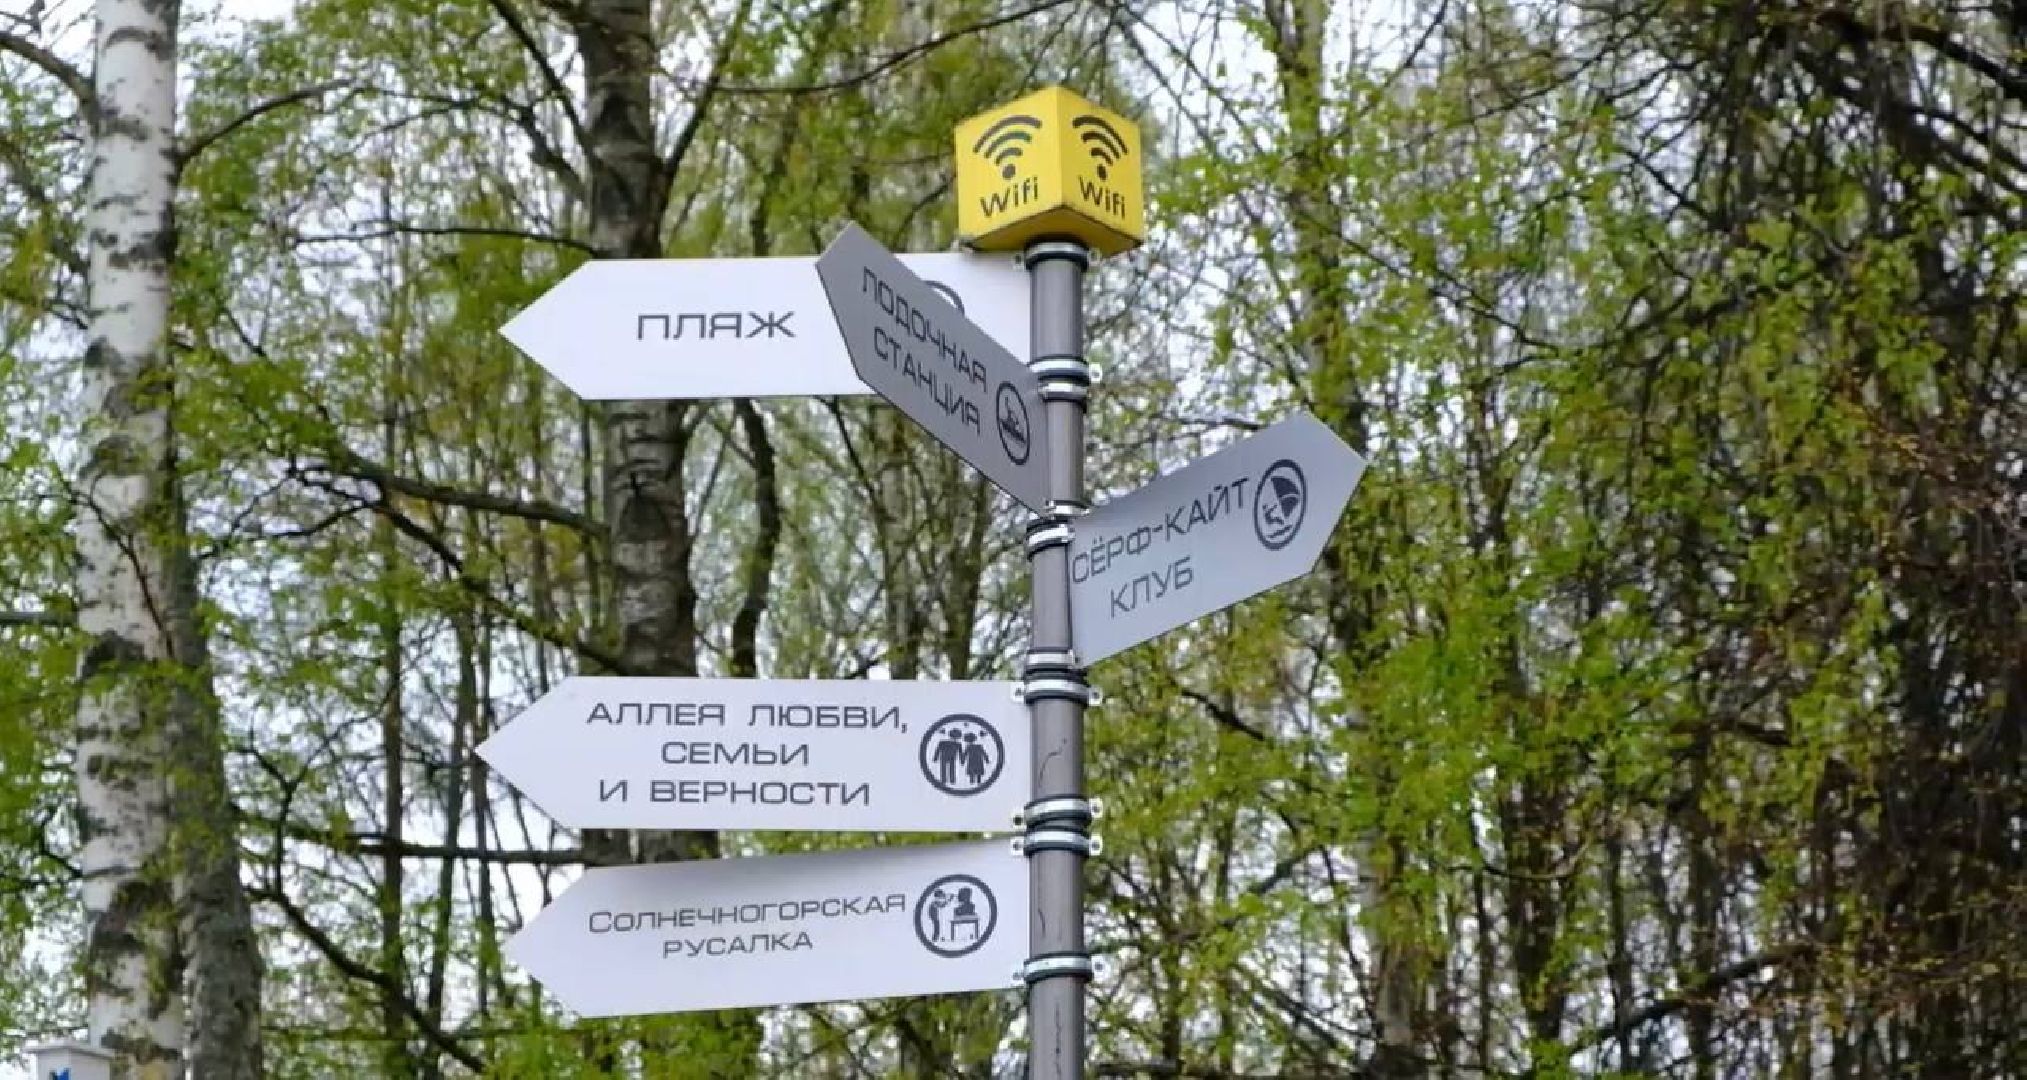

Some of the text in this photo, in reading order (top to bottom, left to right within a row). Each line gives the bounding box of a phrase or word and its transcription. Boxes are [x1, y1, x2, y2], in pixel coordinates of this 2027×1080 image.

[979, 177, 1040, 218] Wifi
[1077, 176, 1127, 218] Wifi
[636, 310, 797, 341] ПЛЯЖ
[861, 266, 988, 393] ЛОДОЧНАЯ
[873, 325, 982, 437] СТАНЦИЯ
[1071, 475, 1250, 584] СЁРФ-КАЙТ
[1110, 554, 1193, 618] КЛУБ
[586, 702, 909, 733] АЛЛЕЯ ЛЮБВИ,
[660, 741, 810, 765] СЕМЬИ
[599, 780, 871, 806] И ВЕРНОСТИ
[662, 931, 813, 960] РУСАЛКА
